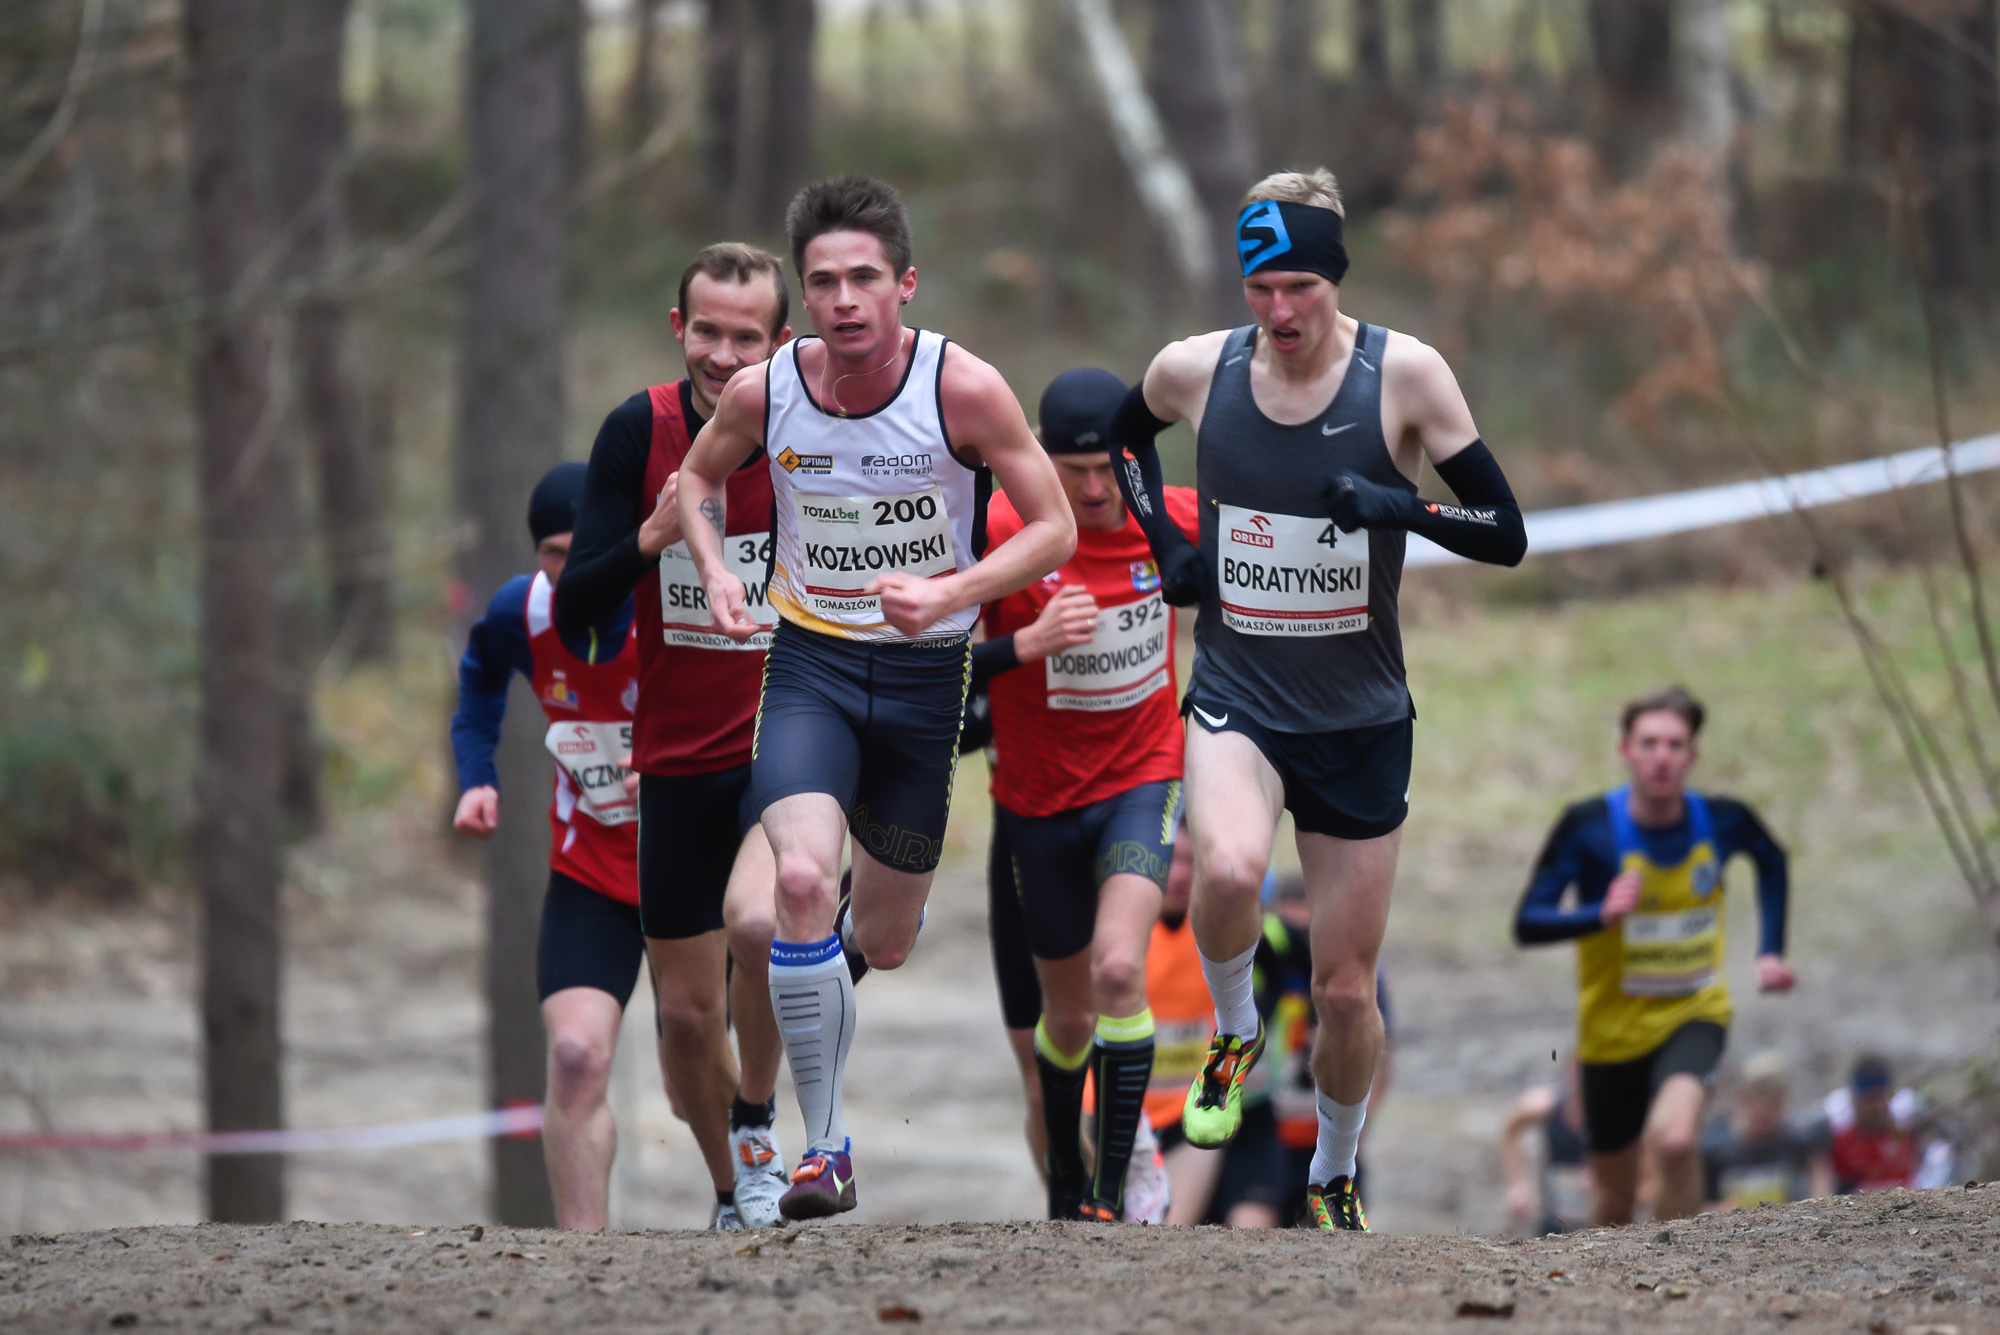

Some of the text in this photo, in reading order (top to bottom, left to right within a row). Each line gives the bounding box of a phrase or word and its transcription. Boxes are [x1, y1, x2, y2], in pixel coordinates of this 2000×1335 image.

[800, 457, 831, 467] OPTIMA
[894, 465, 933, 477] precyzji
[802, 505, 860, 520] TOTALbet
[872, 495, 937, 526] 200
[1437, 503, 1473, 517] ROYAL
[1473, 509, 1496, 520] BAY
[1232, 530, 1272, 548] ORLEN
[1317, 523, 1338, 549] 4
[805, 533, 947, 572] KOZŁOWSKI
[1224, 557, 1361, 593] BORATYŃSKI
[814, 598, 877, 611] TOMASZÓW
[1117, 597, 1163, 632] 392
[1227, 613, 1362, 632] TOMASZÓW LUBELSKI 2021
[671, 633, 731, 646] TOMASZÓW
[1051, 631, 1164, 676] DOBROWOLSKI
